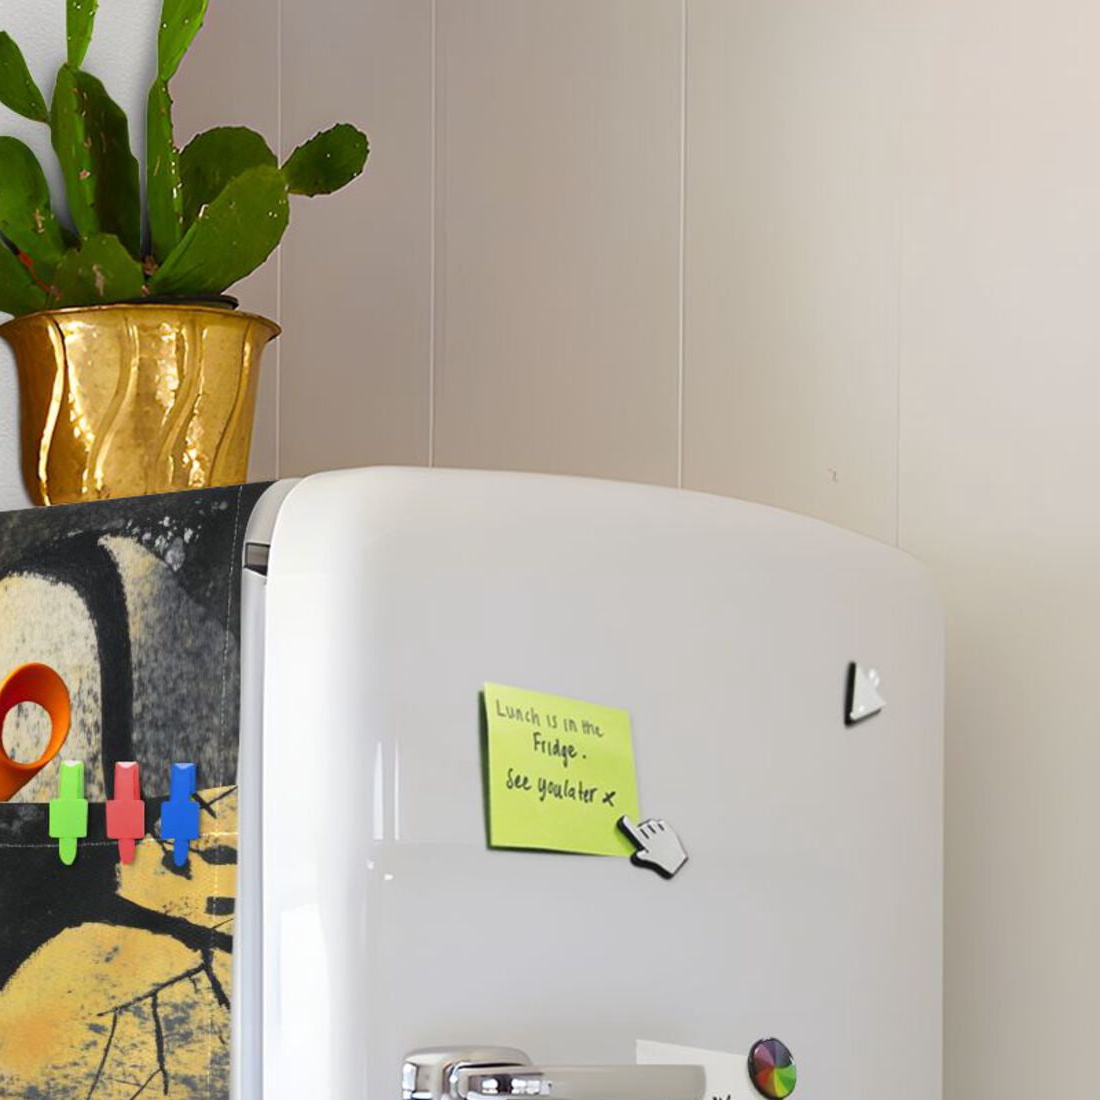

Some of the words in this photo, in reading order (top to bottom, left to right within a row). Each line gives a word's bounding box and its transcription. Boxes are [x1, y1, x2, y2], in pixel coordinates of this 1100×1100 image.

[495, 698, 541, 727] Lunch
[546, 714, 558, 729] is
[563, 717, 578, 733] in
[582, 720, 604, 738] the
[506, 767, 532, 790] See
